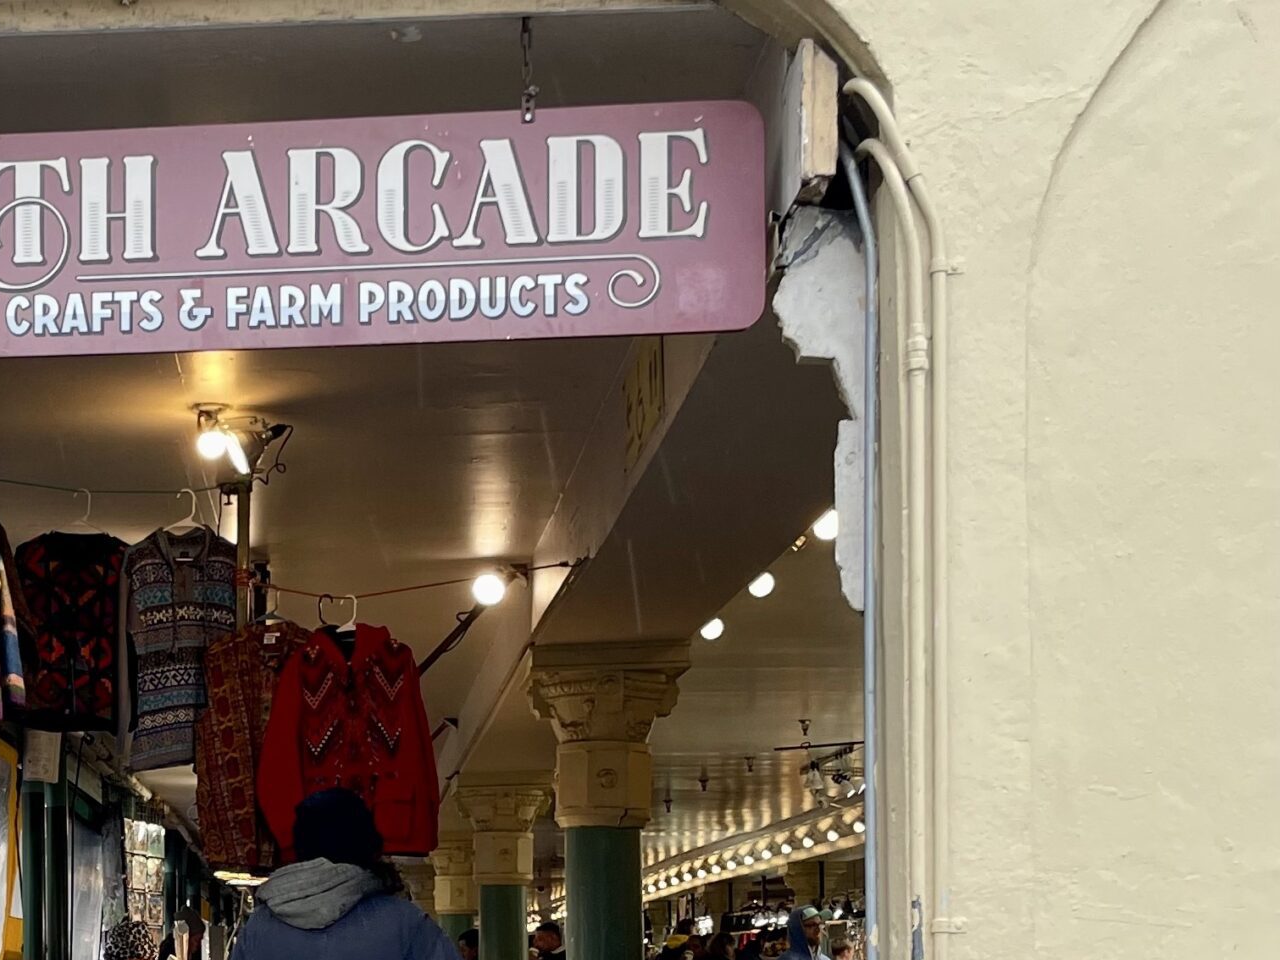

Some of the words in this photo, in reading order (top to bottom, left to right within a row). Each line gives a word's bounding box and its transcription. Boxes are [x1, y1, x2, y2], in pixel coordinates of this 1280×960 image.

[196, 127, 709, 258] ARCADE
[4, 286, 164, 333] CRAFTS
[178, 289, 212, 329] &
[225, 281, 343, 329] FARM
[358, 271, 590, 323] PRODUCTS
